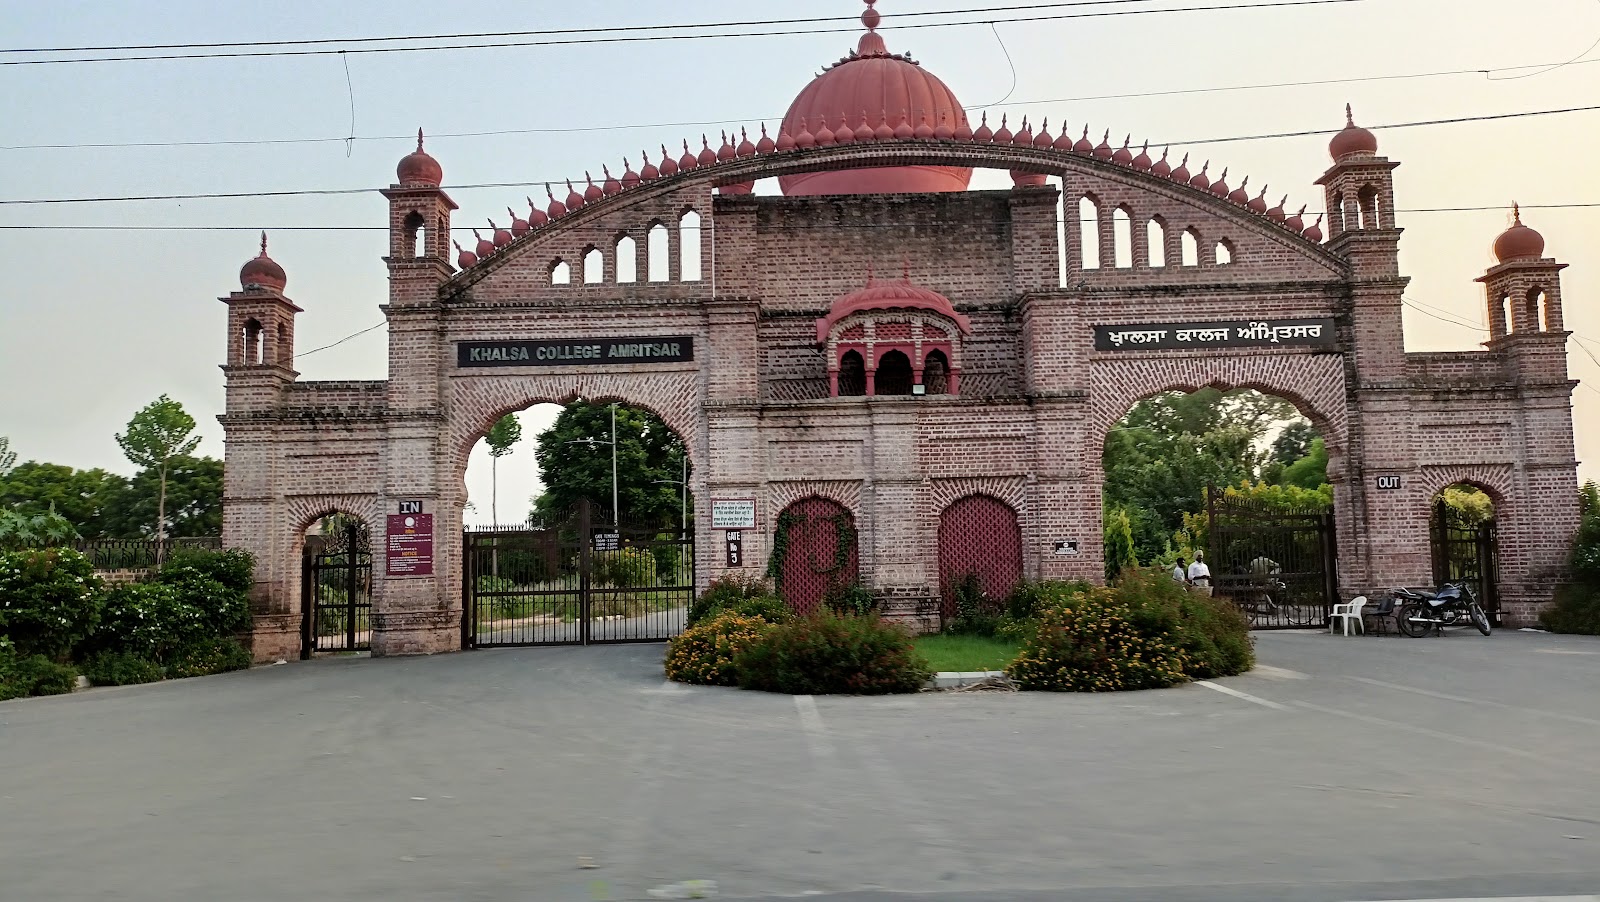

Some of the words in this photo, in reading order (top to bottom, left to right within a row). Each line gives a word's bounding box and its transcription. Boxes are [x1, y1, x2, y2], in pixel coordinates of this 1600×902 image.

[1175, 328, 1229, 342] ਕਾਲਜ
[1237, 322, 1323, 343] ਅੰਮ੍ਰਿਤਸਰ
[469, 346, 529, 361] KHALSA
[536, 345, 602, 360] COLLEGE
[607, 343, 681, 358] AMRITSAR
[1379, 477, 1399, 488] OUT
[401, 502, 419, 513] IN
[727, 531, 741, 541] GATE
[731, 553, 738, 563] 3
